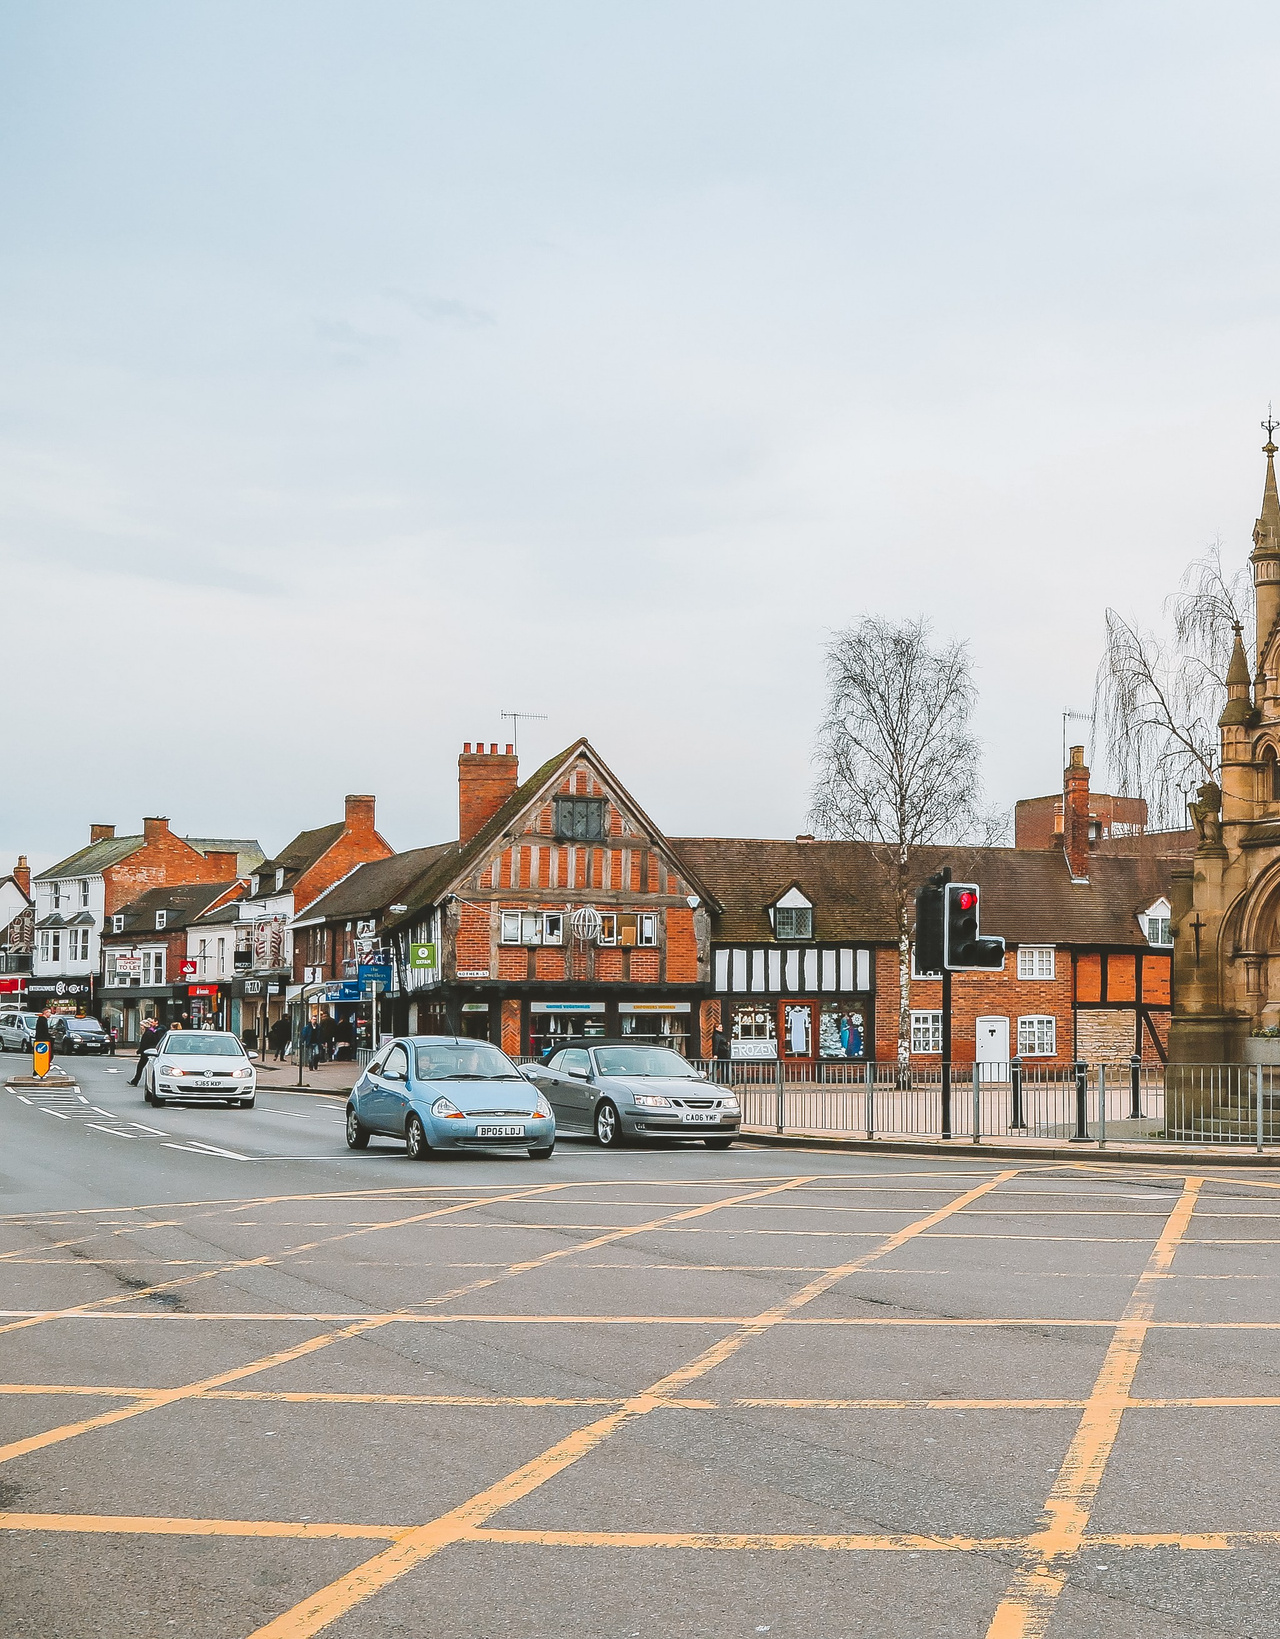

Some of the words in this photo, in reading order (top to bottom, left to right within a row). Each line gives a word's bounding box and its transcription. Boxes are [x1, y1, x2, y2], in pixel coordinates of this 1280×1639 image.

[731, 1043, 777, 1057] FROZEN
[480, 1127, 503, 1136] BP05
[504, 1127, 521, 1136] LDJ
